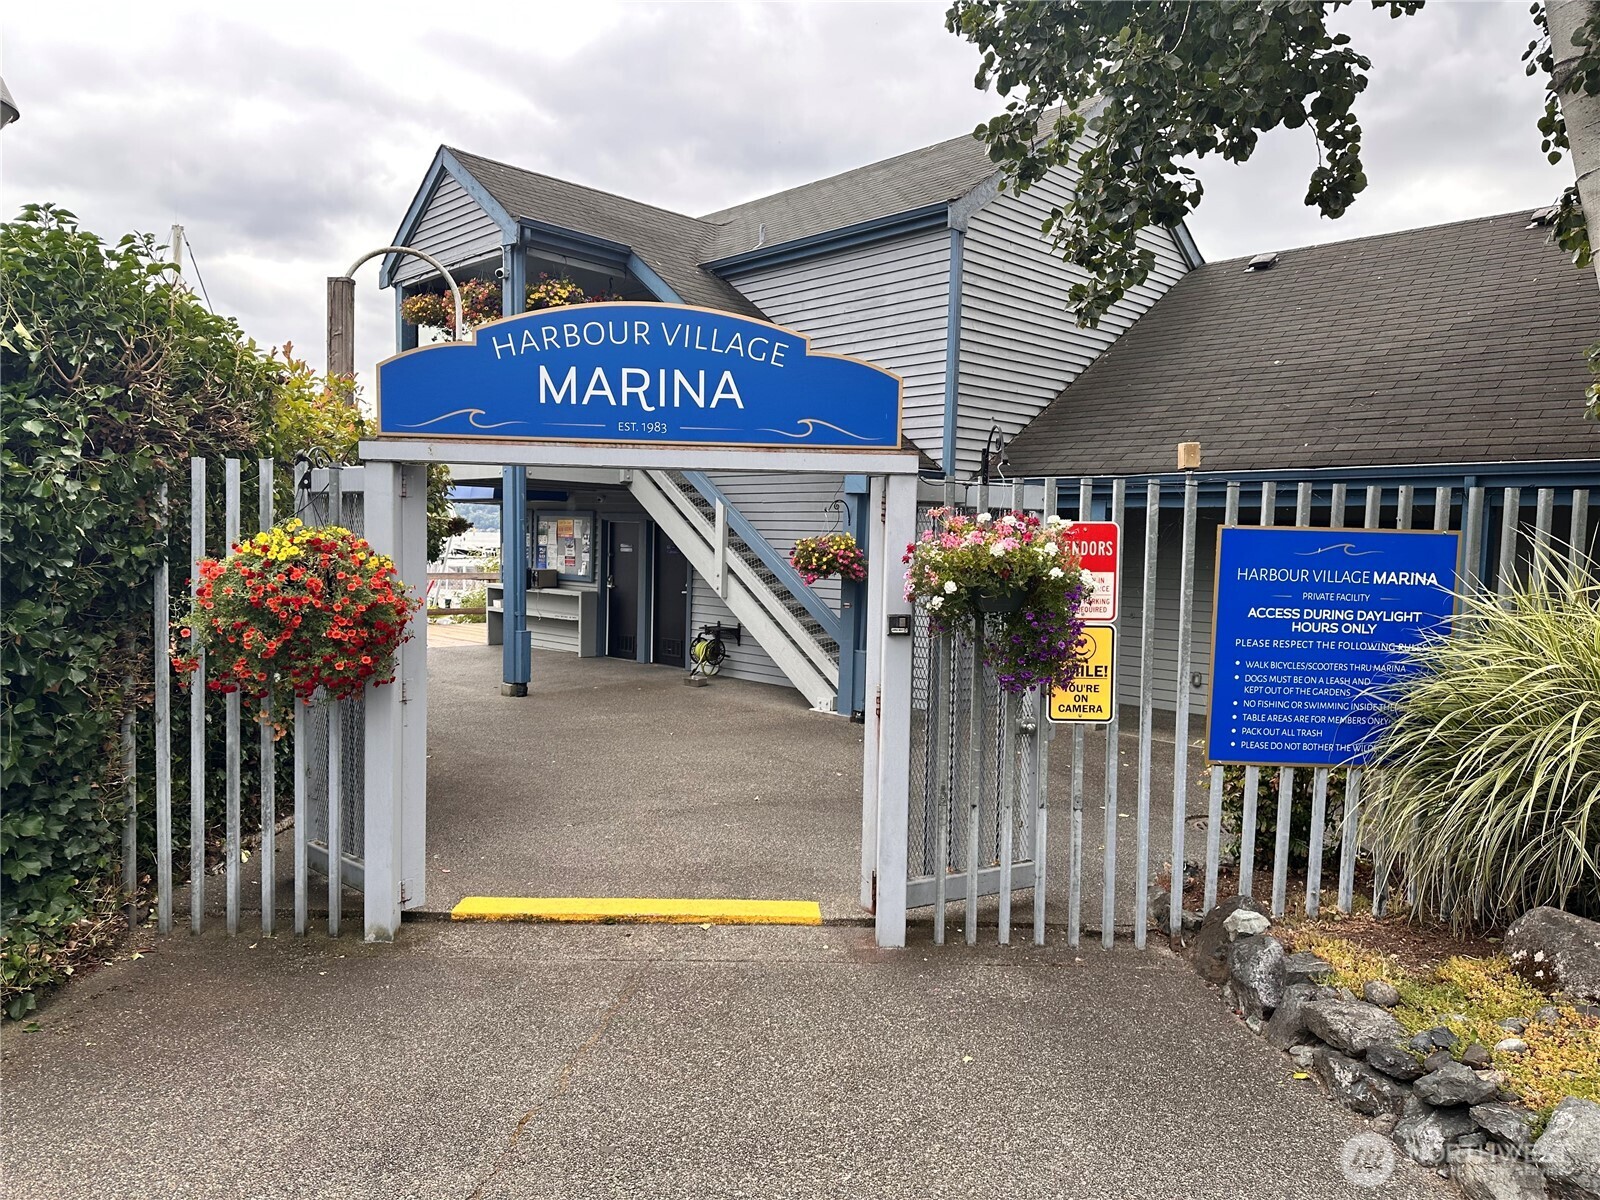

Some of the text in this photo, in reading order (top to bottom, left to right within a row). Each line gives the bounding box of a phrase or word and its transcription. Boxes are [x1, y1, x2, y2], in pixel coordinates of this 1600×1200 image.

[491, 321, 790, 368] HARBOUR VILLAGE
[539, 365, 744, 412] MARINA
[618, 422, 668, 434] EST. 1983
[1064, 540, 1113, 556] ENDORS
[1237, 568, 1438, 585] HARBOUR VILLAGE MARINA
[1302, 592, 1370, 602] PRIVATE FACILITY
[1248, 607, 1422, 622] ACCESS DURING DAYLIGHT
[1292, 622, 1377, 634] HOURS ONLY
[1236, 638, 1428, 652] PLEASE RESPECT THE FOLLOWING RULS
[1271, 662, 1348, 671] BICYCLES/SCOOTERS
[1326, 677, 1350, 685] LEASH
[1312, 688, 1350, 696] GARDENS
[1058, 704, 1102, 713] CAMERA
[1304, 702, 1349, 710] SWIMMING
[1351, 703, 1378, 711] INSIDE
[1267, 714, 1292, 722] AREAS
[1327, 716, 1366, 724] MEMBERS
[1242, 727, 1262, 735] PACK
[1263, 728, 1280, 736] OUT
[1297, 729, 1322, 737] TRASH
[1241, 741, 1269, 749] PLEASE
[1303, 743, 1333, 751] BOTHER
